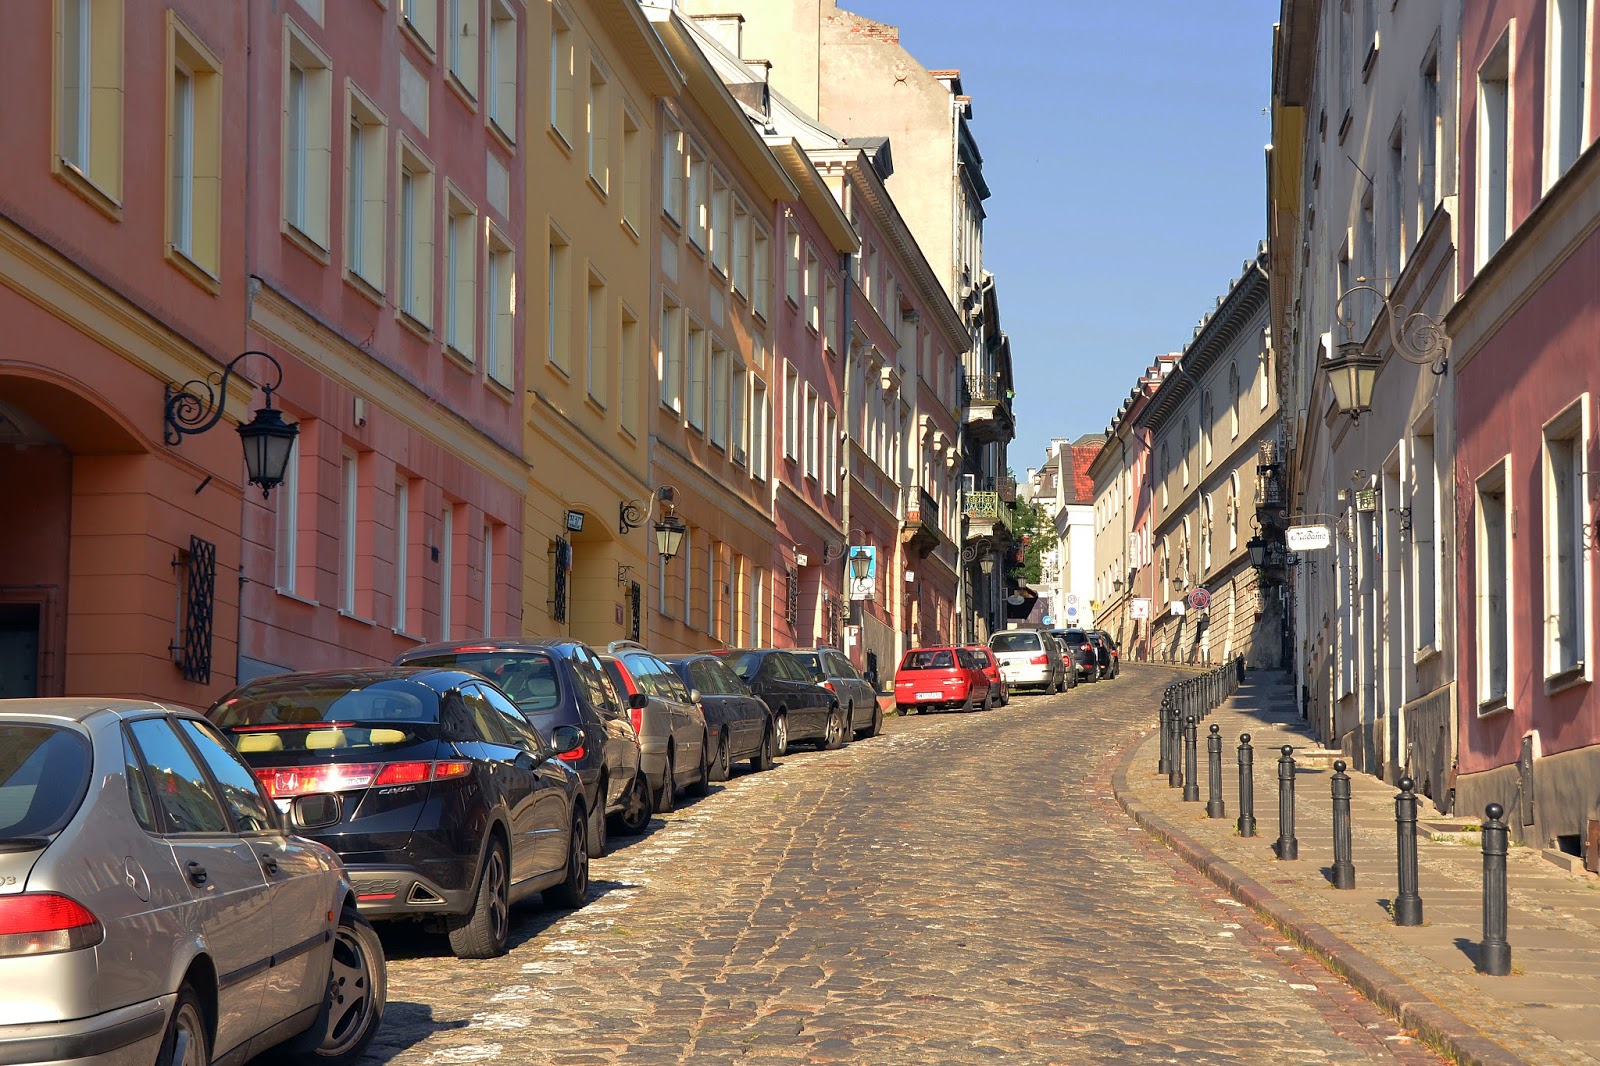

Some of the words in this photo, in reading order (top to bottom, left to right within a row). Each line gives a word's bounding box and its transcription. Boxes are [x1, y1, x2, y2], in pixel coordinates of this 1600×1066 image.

[1291, 530, 1326, 541] Madame
[851, 628, 858, 636] P
[379, 785, 416, 795] CIVIC
